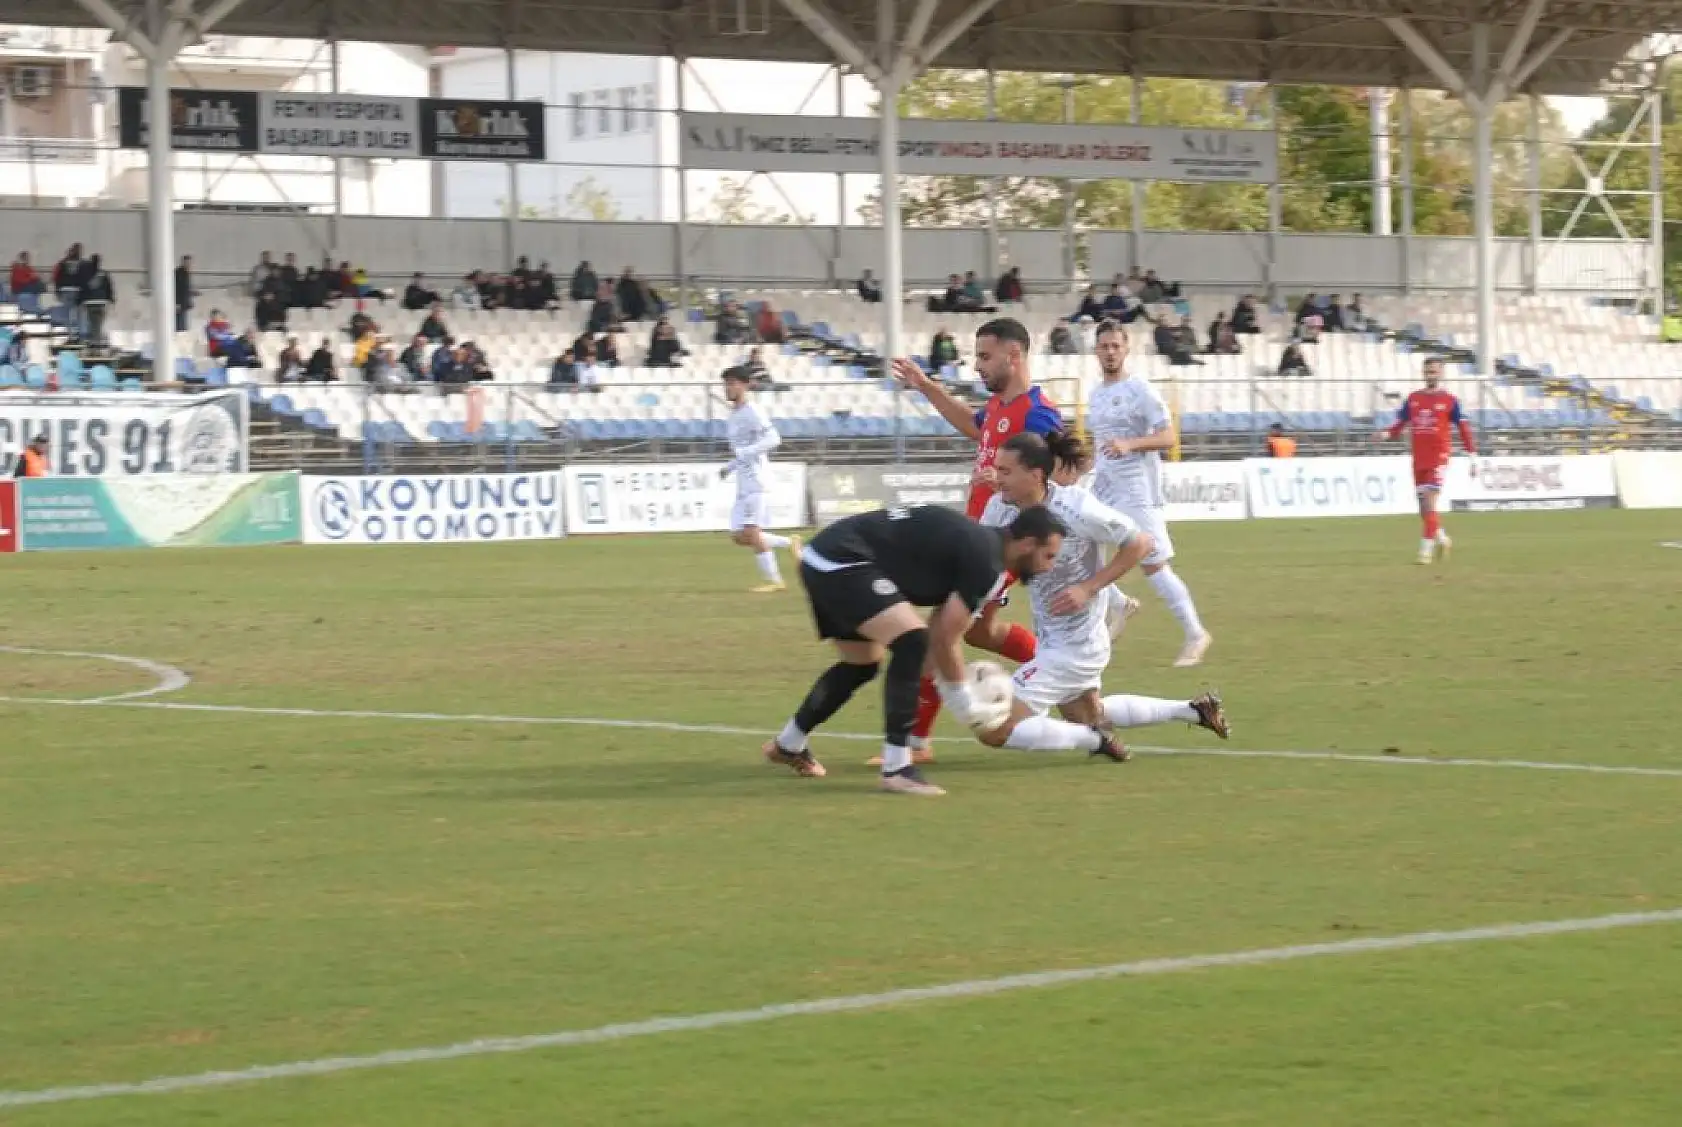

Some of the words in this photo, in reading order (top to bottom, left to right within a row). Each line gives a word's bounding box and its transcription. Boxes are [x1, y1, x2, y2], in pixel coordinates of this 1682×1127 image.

[122, 418, 174, 474] 91
[360, 475, 557, 511] KOYUNCU
[613, 472, 708, 492] HERDEM
